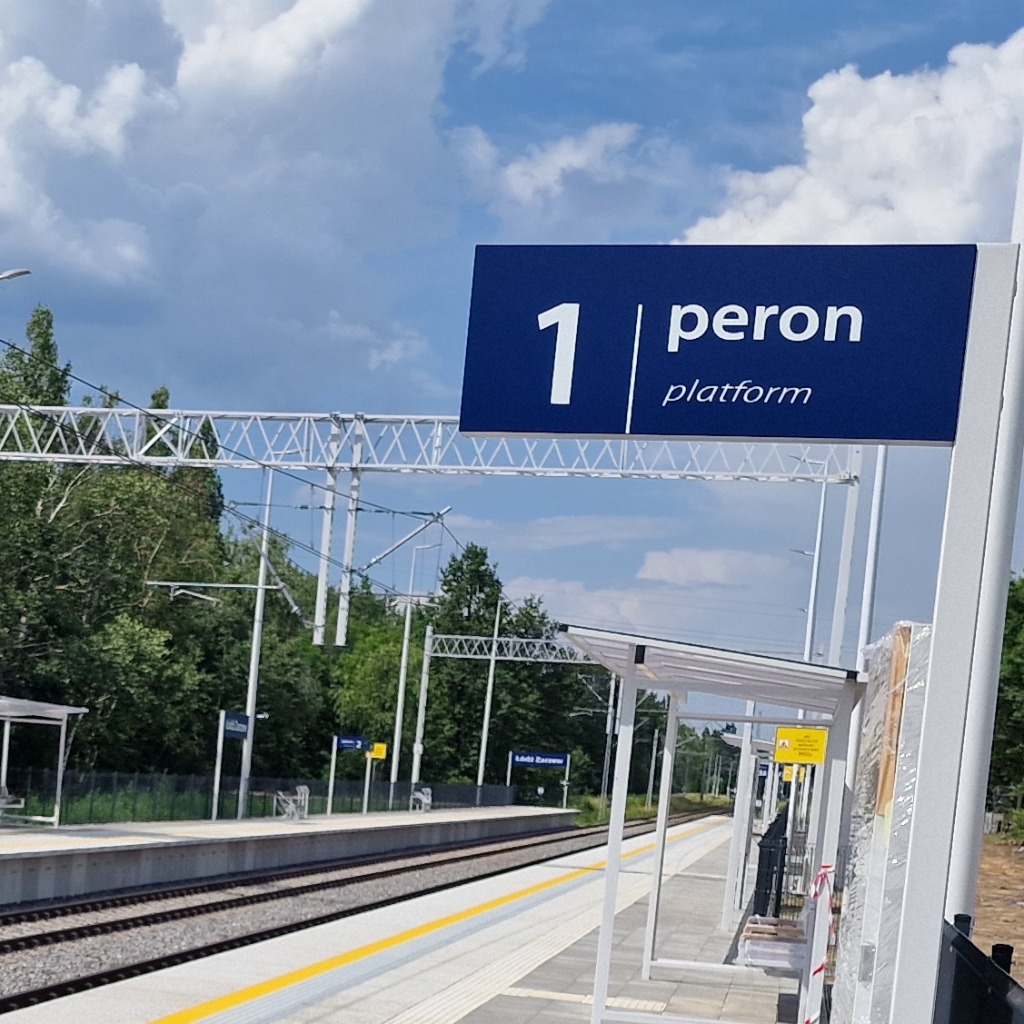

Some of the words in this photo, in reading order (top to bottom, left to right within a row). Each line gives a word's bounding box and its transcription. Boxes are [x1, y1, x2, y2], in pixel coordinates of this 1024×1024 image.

[537, 302, 580, 405] 1
[667, 302, 863, 353] peron
[662, 379, 812, 407] platform
